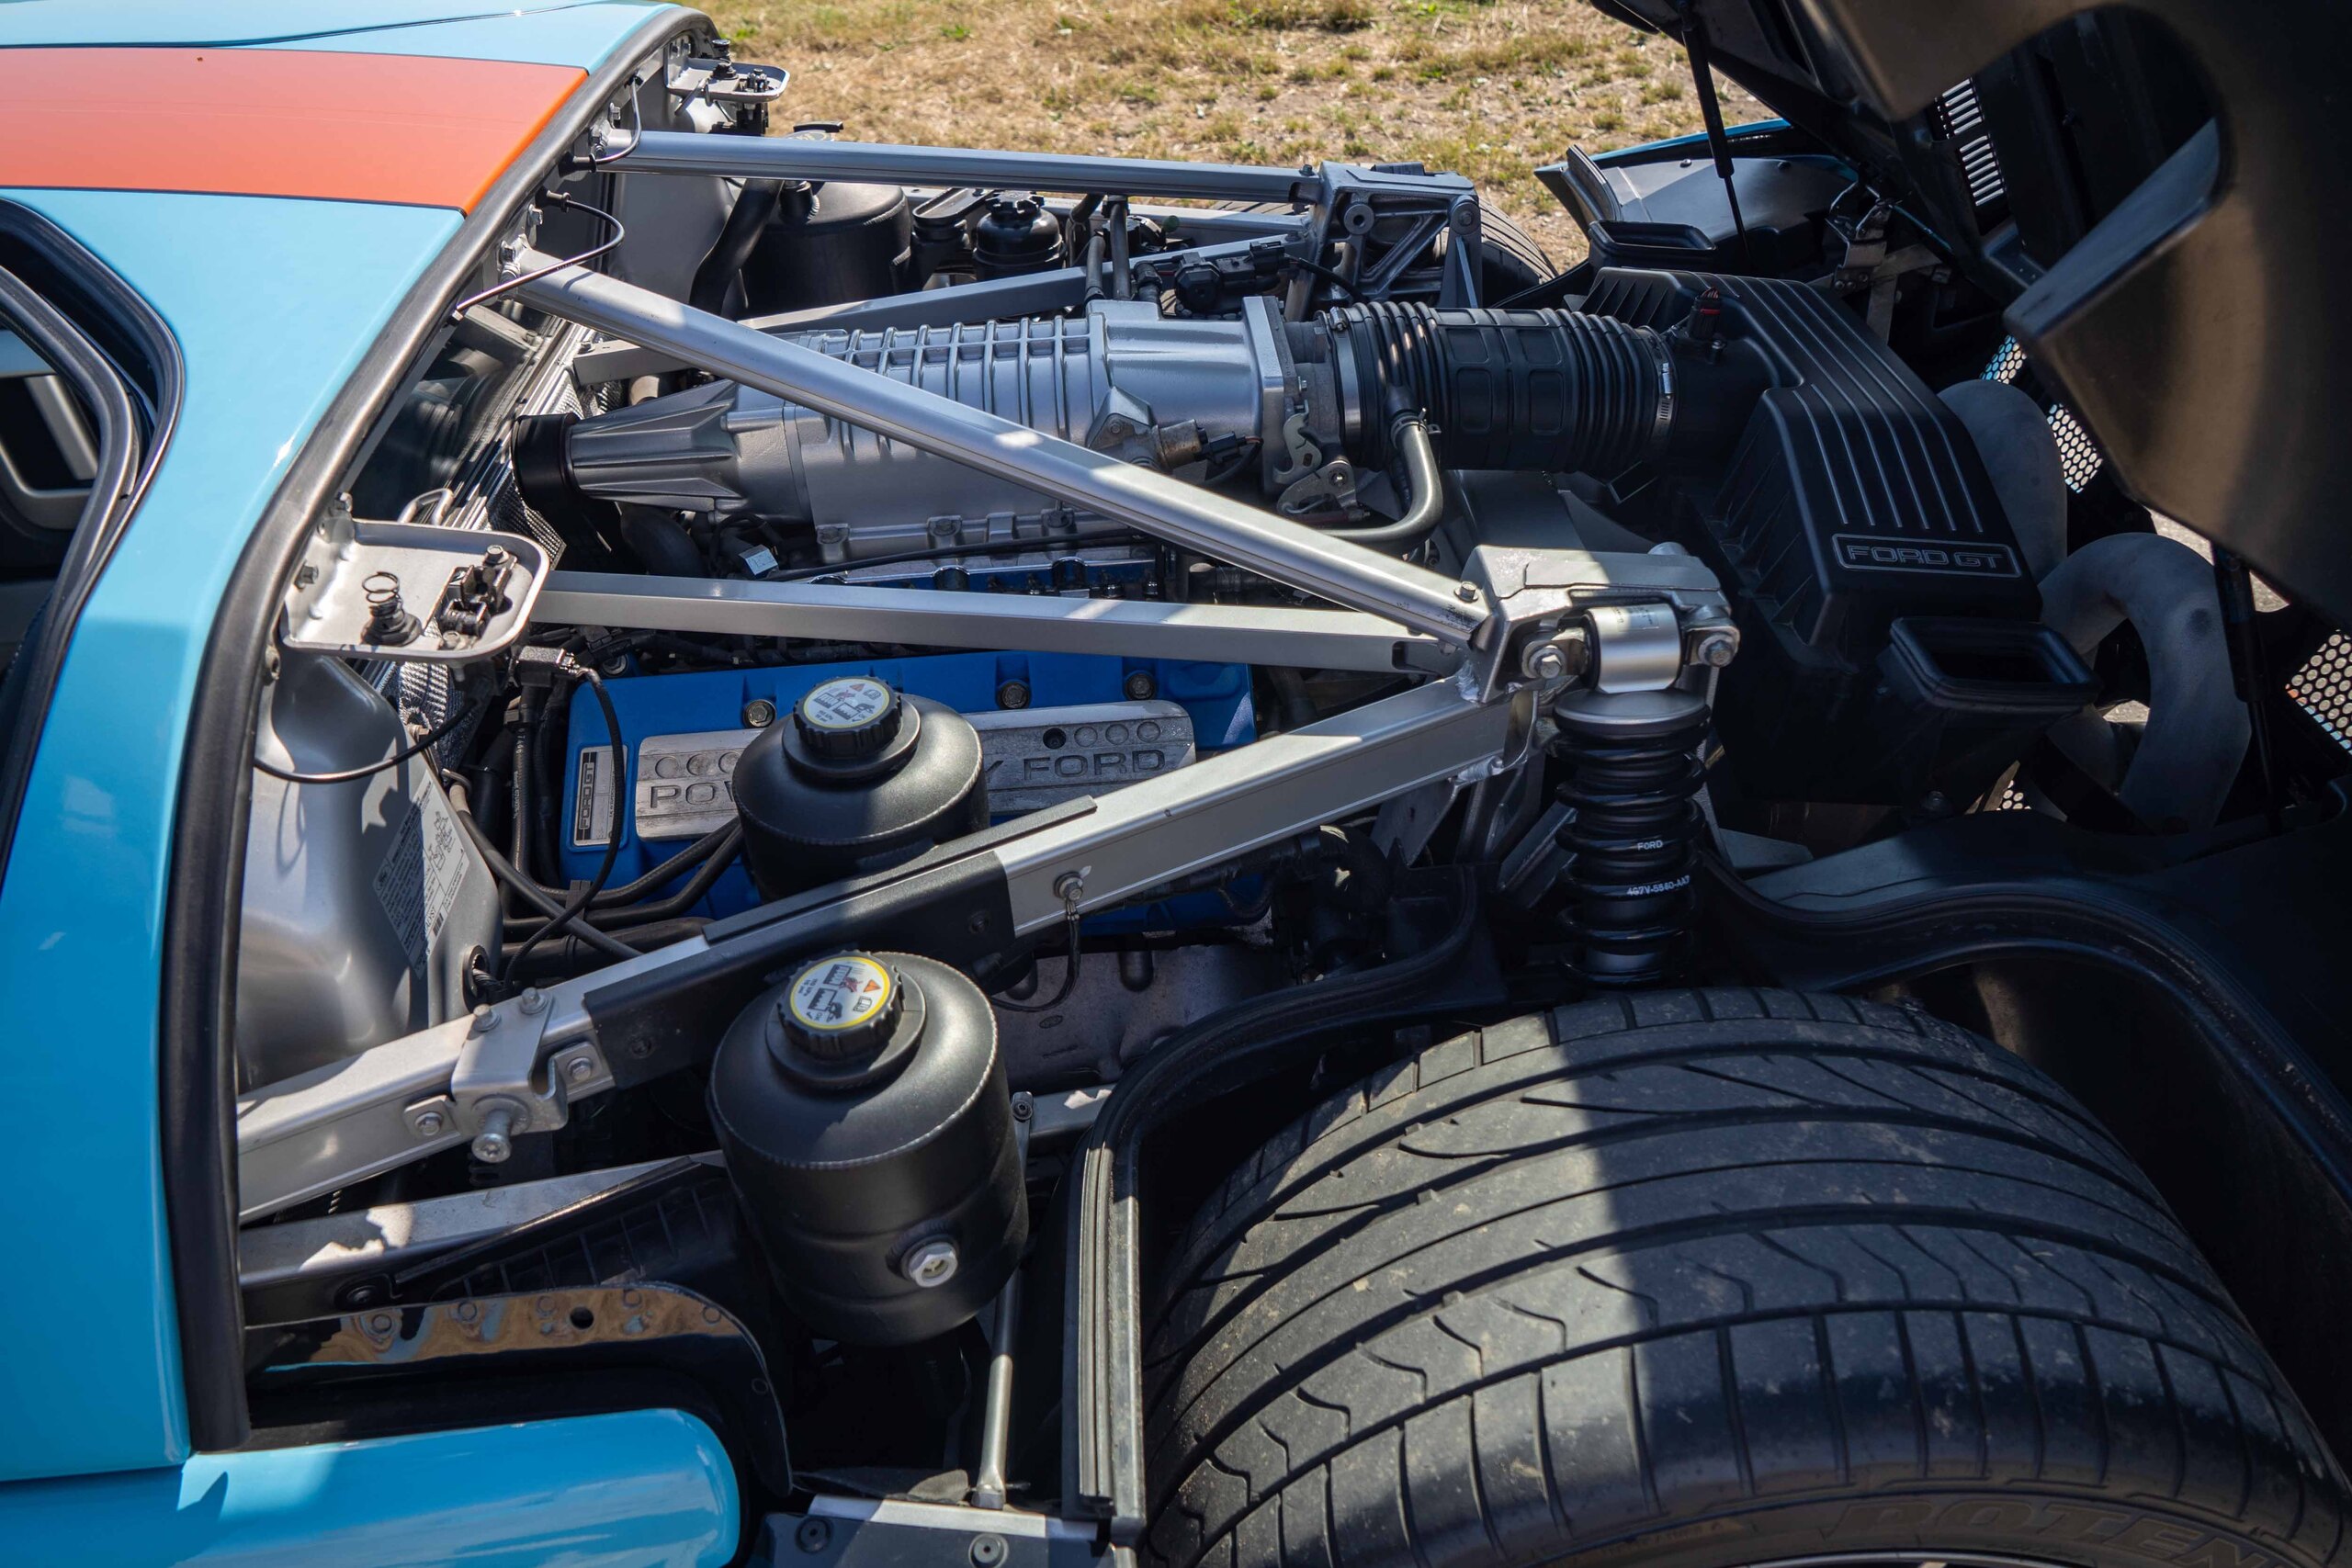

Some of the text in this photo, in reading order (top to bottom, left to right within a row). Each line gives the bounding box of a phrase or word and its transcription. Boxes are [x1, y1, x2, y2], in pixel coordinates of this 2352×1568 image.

[1847, 544, 2005, 569] FORD GT
[1023, 749, 1167, 781] FORD
[580, 763, 594, 829] FORD GT
[1637, 840, 1664, 851] FORD
